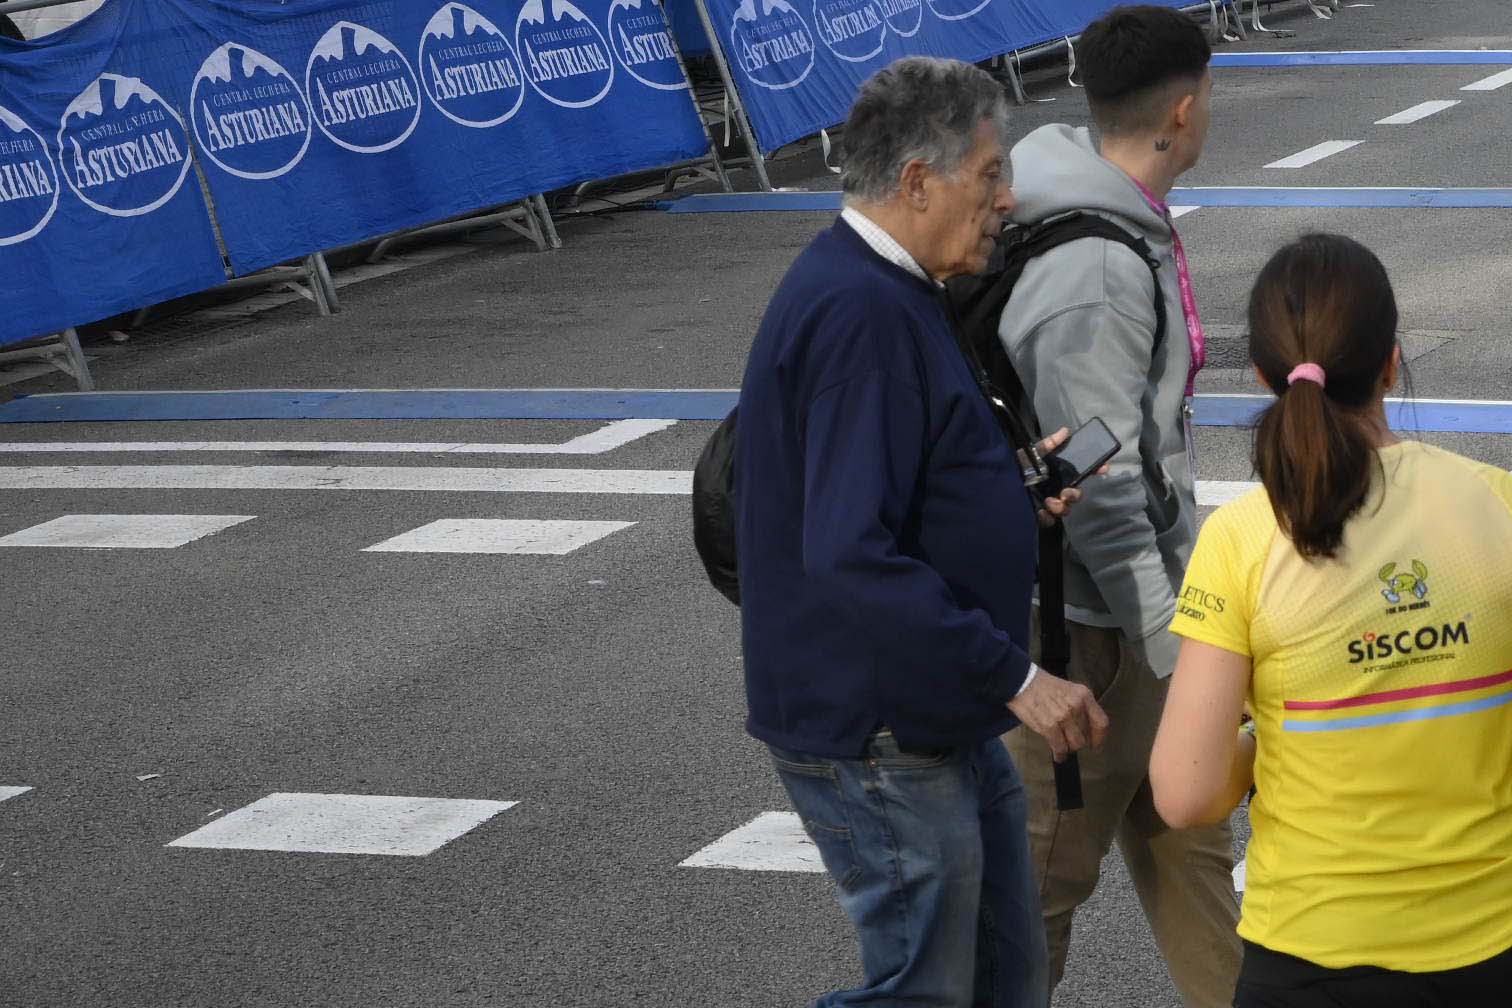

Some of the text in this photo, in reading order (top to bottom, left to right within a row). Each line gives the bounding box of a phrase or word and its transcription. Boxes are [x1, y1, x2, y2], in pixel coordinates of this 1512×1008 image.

[524, 38, 610, 83] ASTURIANA
[618, 22, 679, 67] ASTUR
[428, 53, 520, 102] ASTURIANA
[316, 76, 417, 127] ASTURIANA
[202, 99, 306, 152] ASTURIANA
[1182, 586, 1226, 613] ETICS
